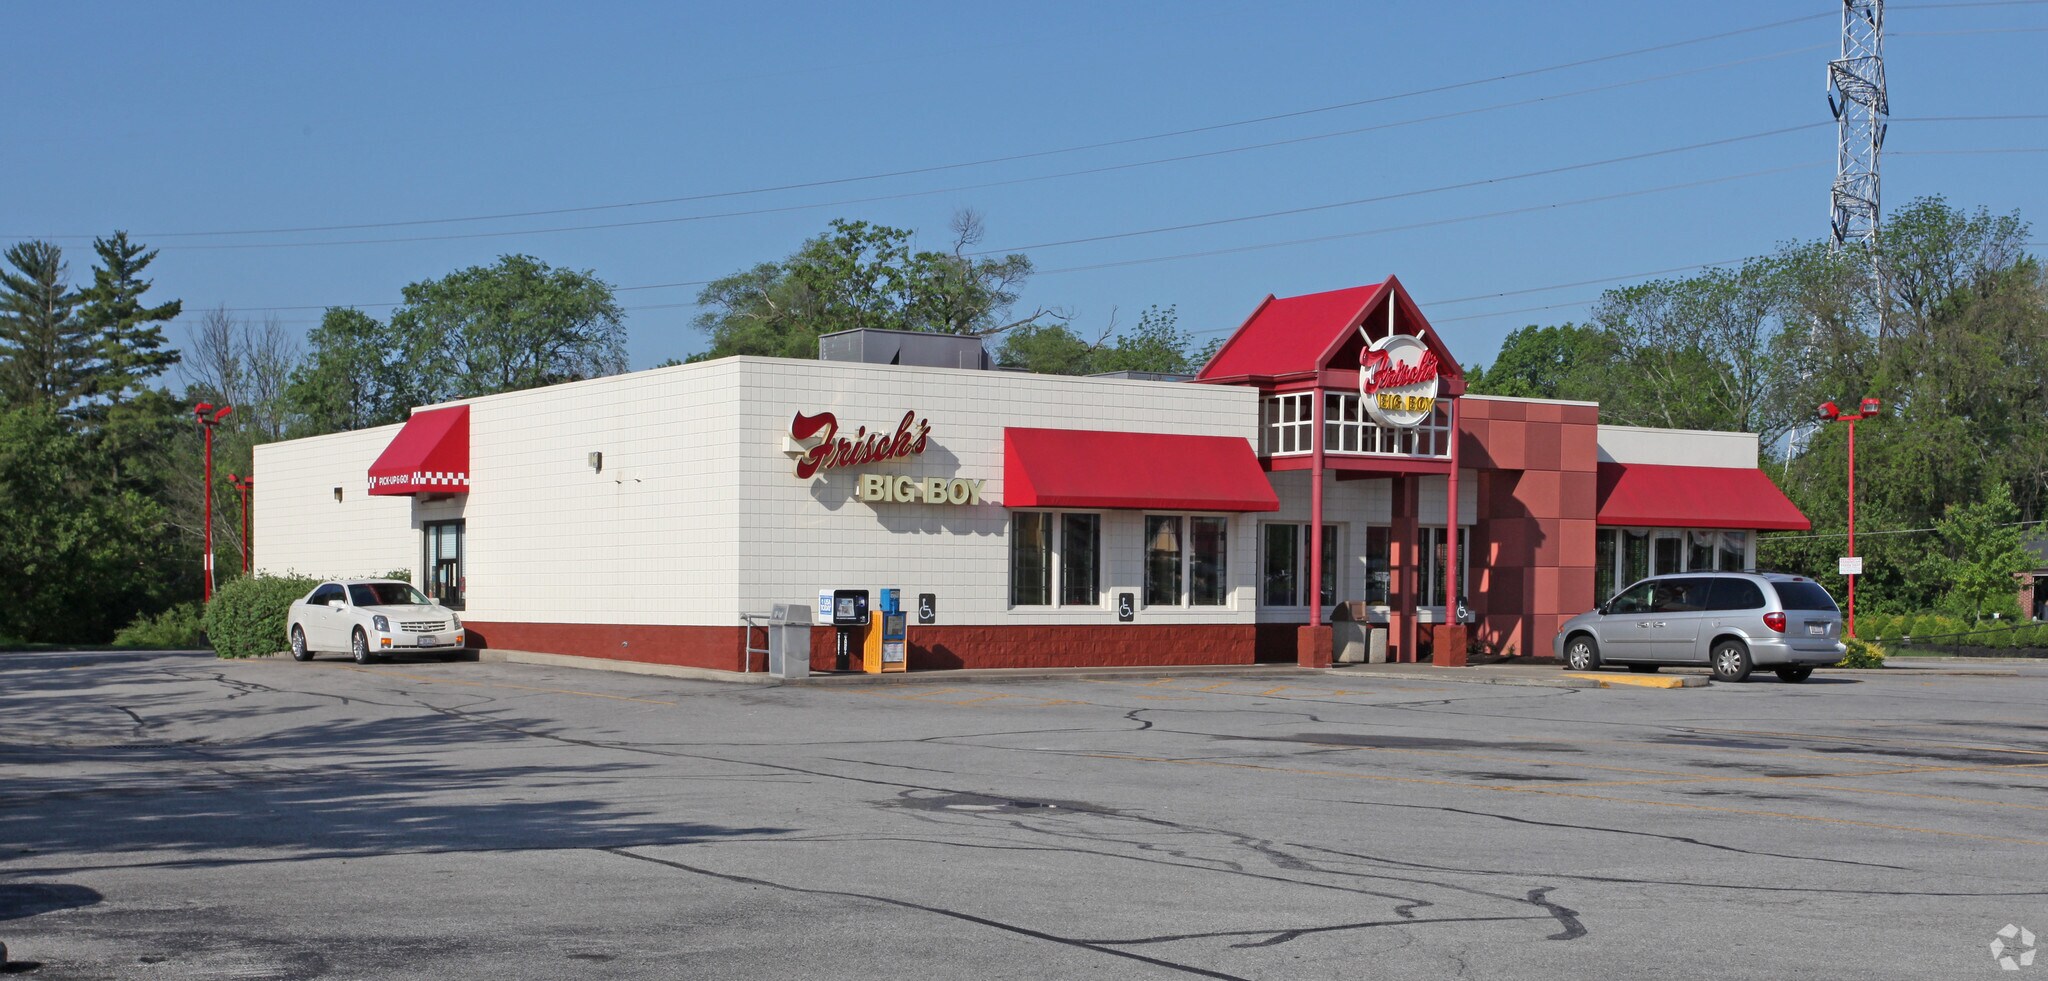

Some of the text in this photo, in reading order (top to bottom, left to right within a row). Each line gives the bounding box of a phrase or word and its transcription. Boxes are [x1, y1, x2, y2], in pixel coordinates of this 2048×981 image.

[1359, 346, 1438, 394] Frisch's
[1377, 393, 1435, 413] BIG BOY
[790, 409, 932, 480] Frisch's
[859, 473, 987, 506] BIG BOY
